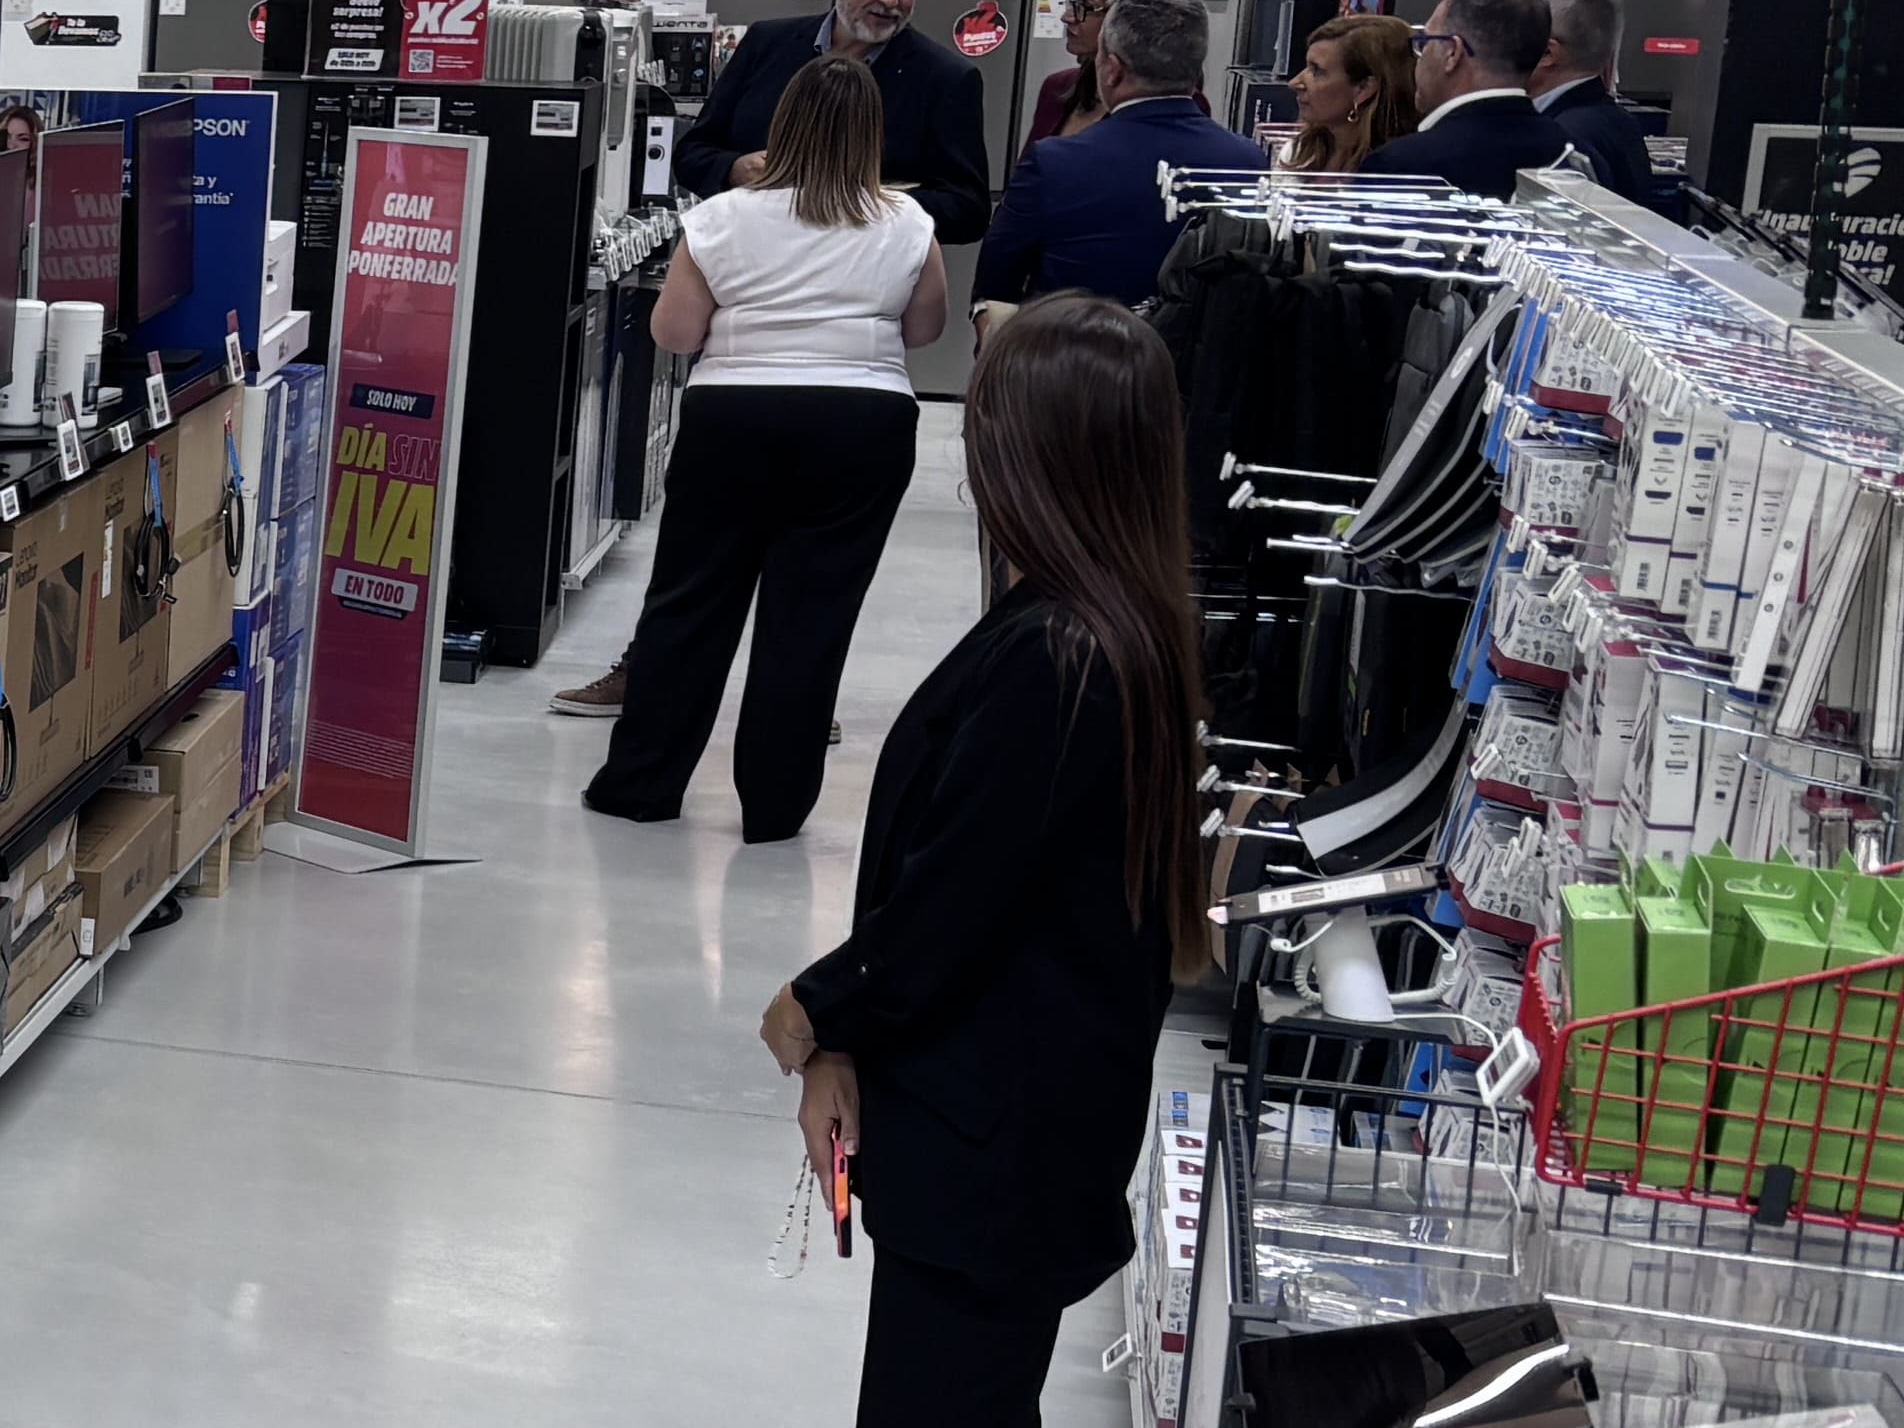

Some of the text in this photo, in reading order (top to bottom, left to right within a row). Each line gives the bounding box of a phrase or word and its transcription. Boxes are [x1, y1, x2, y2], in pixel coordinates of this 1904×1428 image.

[193, 119, 246, 138] PSON
[383, 192, 434, 221] GRAN
[360, 221, 453, 255] APERTURA
[367, 389, 417, 412] SOLO HOY
[336, 423, 441, 481] DÍA SIN
[324, 470, 436, 576] IVA
[344, 575, 405, 604] EN TODO
